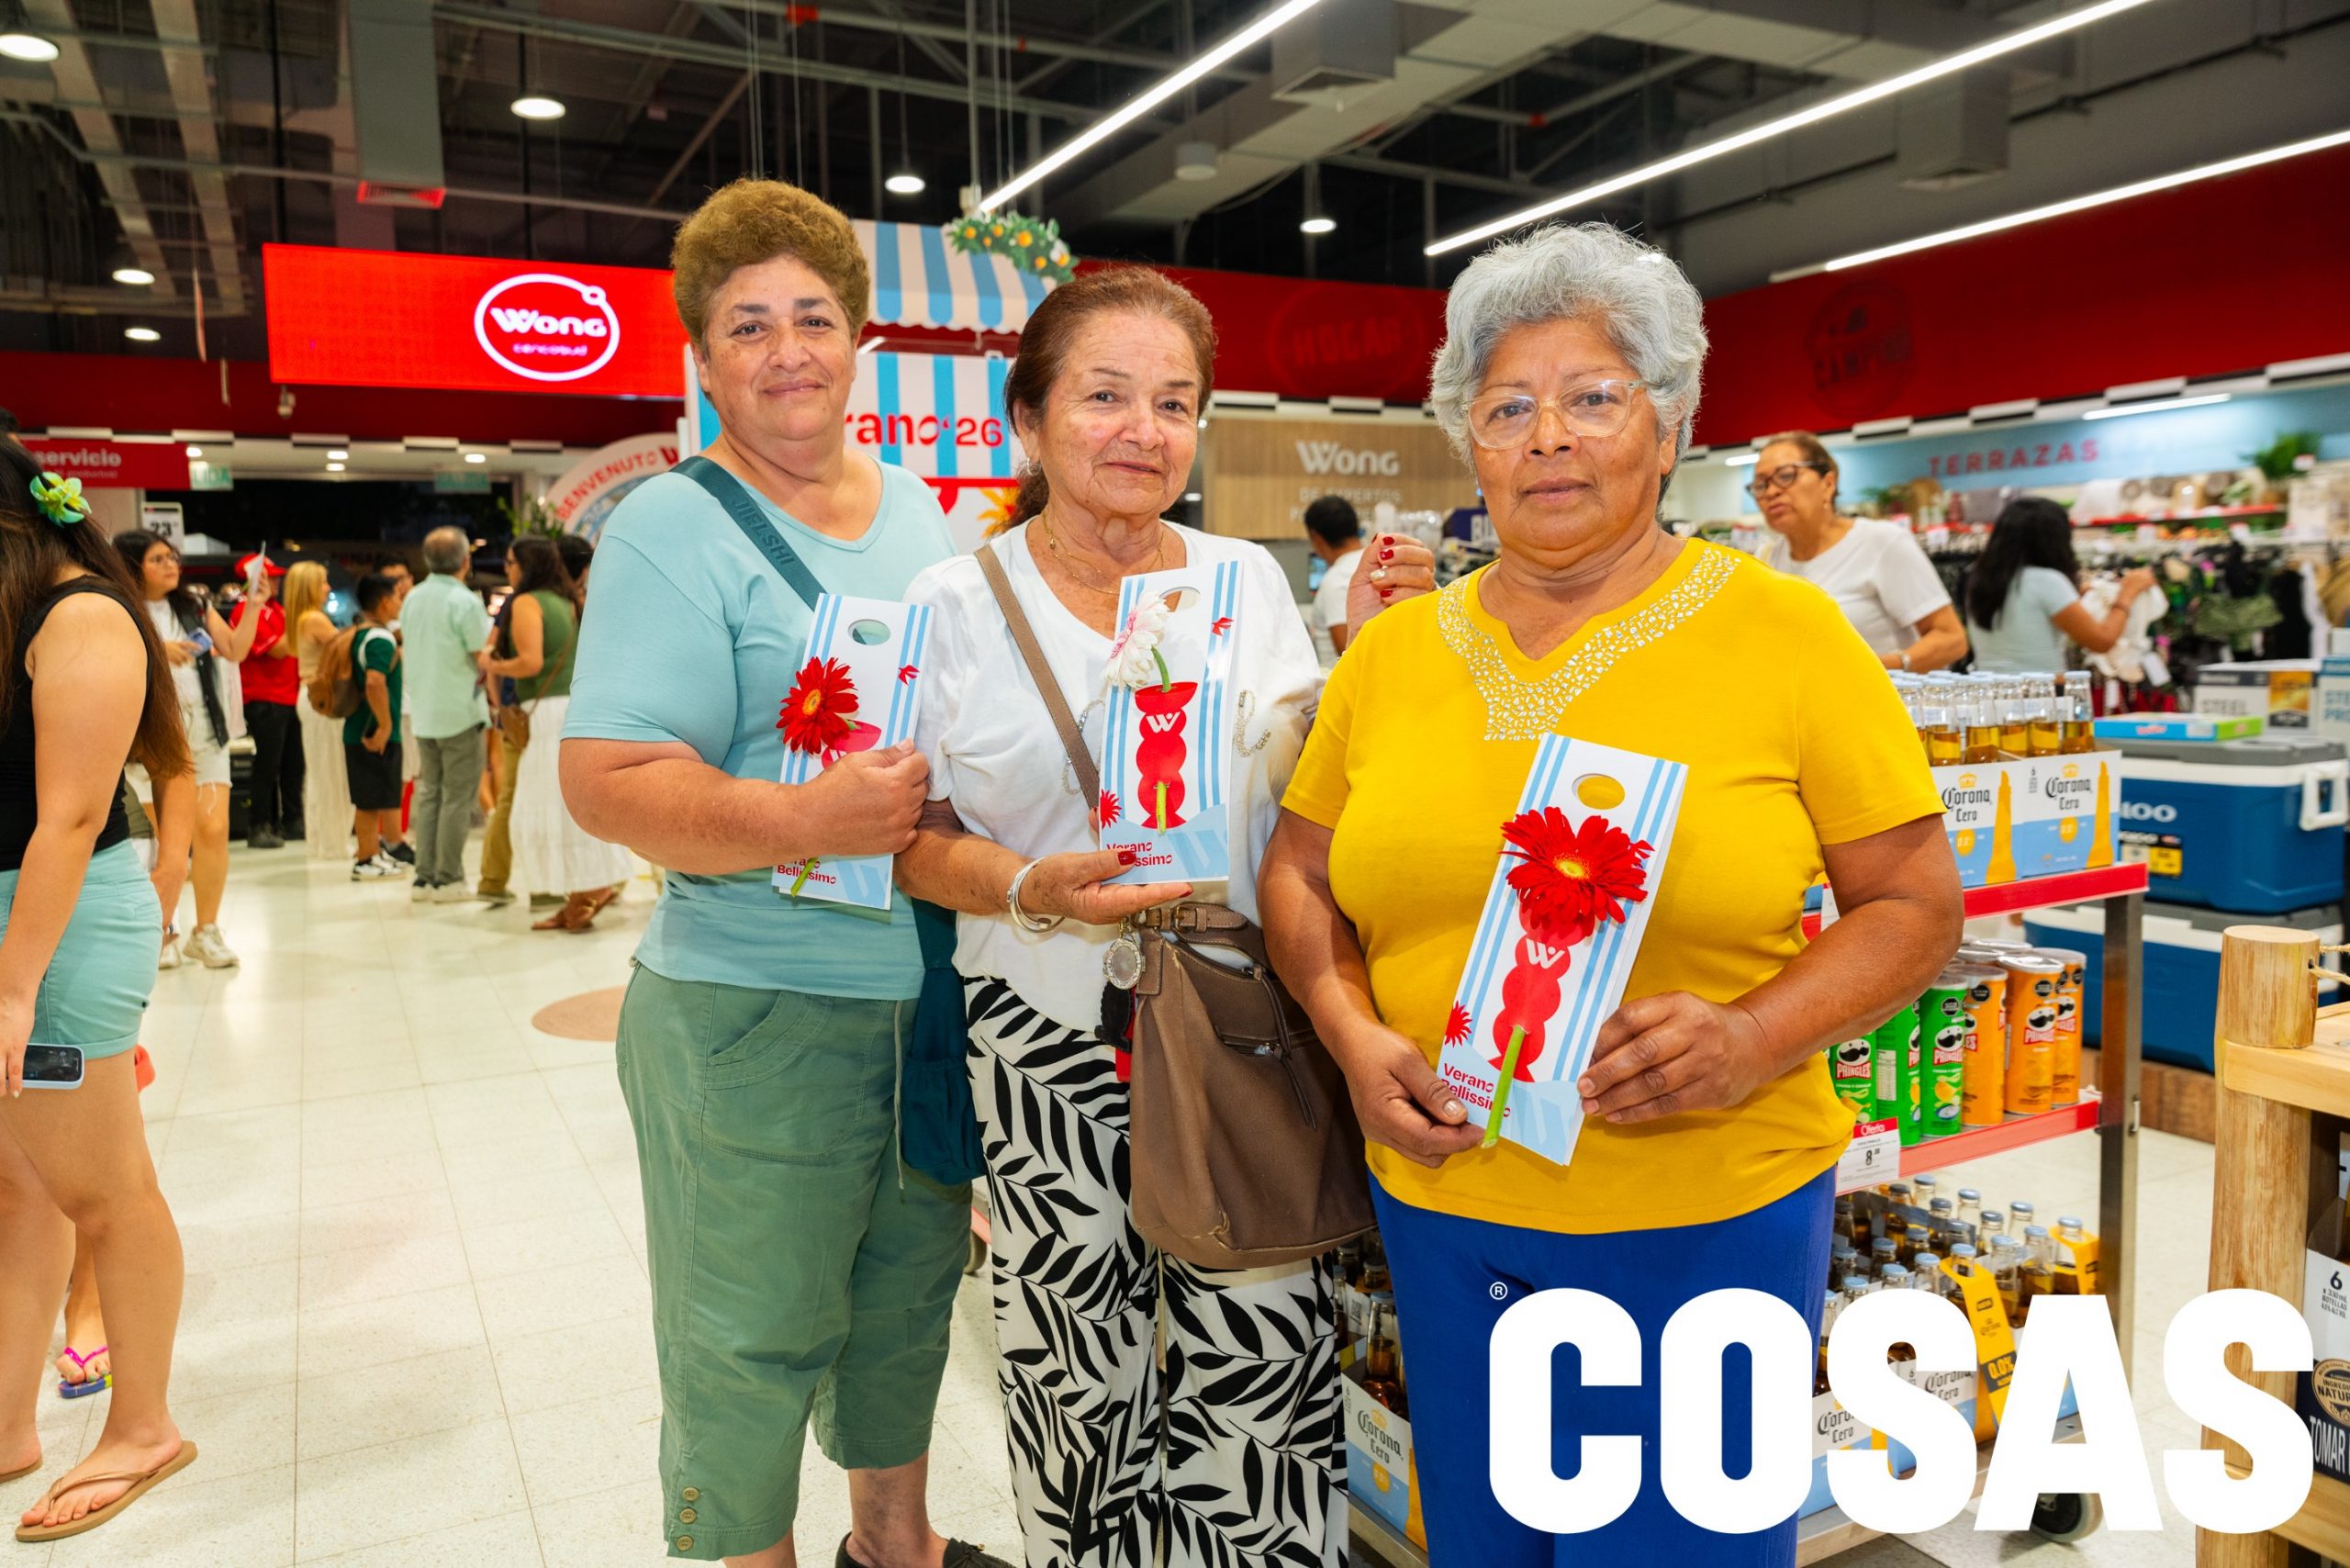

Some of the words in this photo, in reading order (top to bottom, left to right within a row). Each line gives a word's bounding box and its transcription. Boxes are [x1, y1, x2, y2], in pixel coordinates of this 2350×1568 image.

[1929, 438, 2098, 477] TERRAZAS
[1942, 786, 1992, 810] Corona
[2045, 777, 2092, 799] Corona
[2059, 797, 2079, 811] Cero
[1956, 808, 1977, 823] Cero
[1444, 1062, 1494, 1093] Verano
[1836, 1061, 1872, 1080] PRINGLES
[1860, 1124, 1886, 1137] Oferta
[2330, 1270, 2343, 1291] 6
[1357, 1409, 1403, 1458] Corona
[1832, 1427, 1853, 1443] Cero
[2310, 1415, 2346, 1474] TOMAR
[1370, 1437, 1391, 1464] Cero
